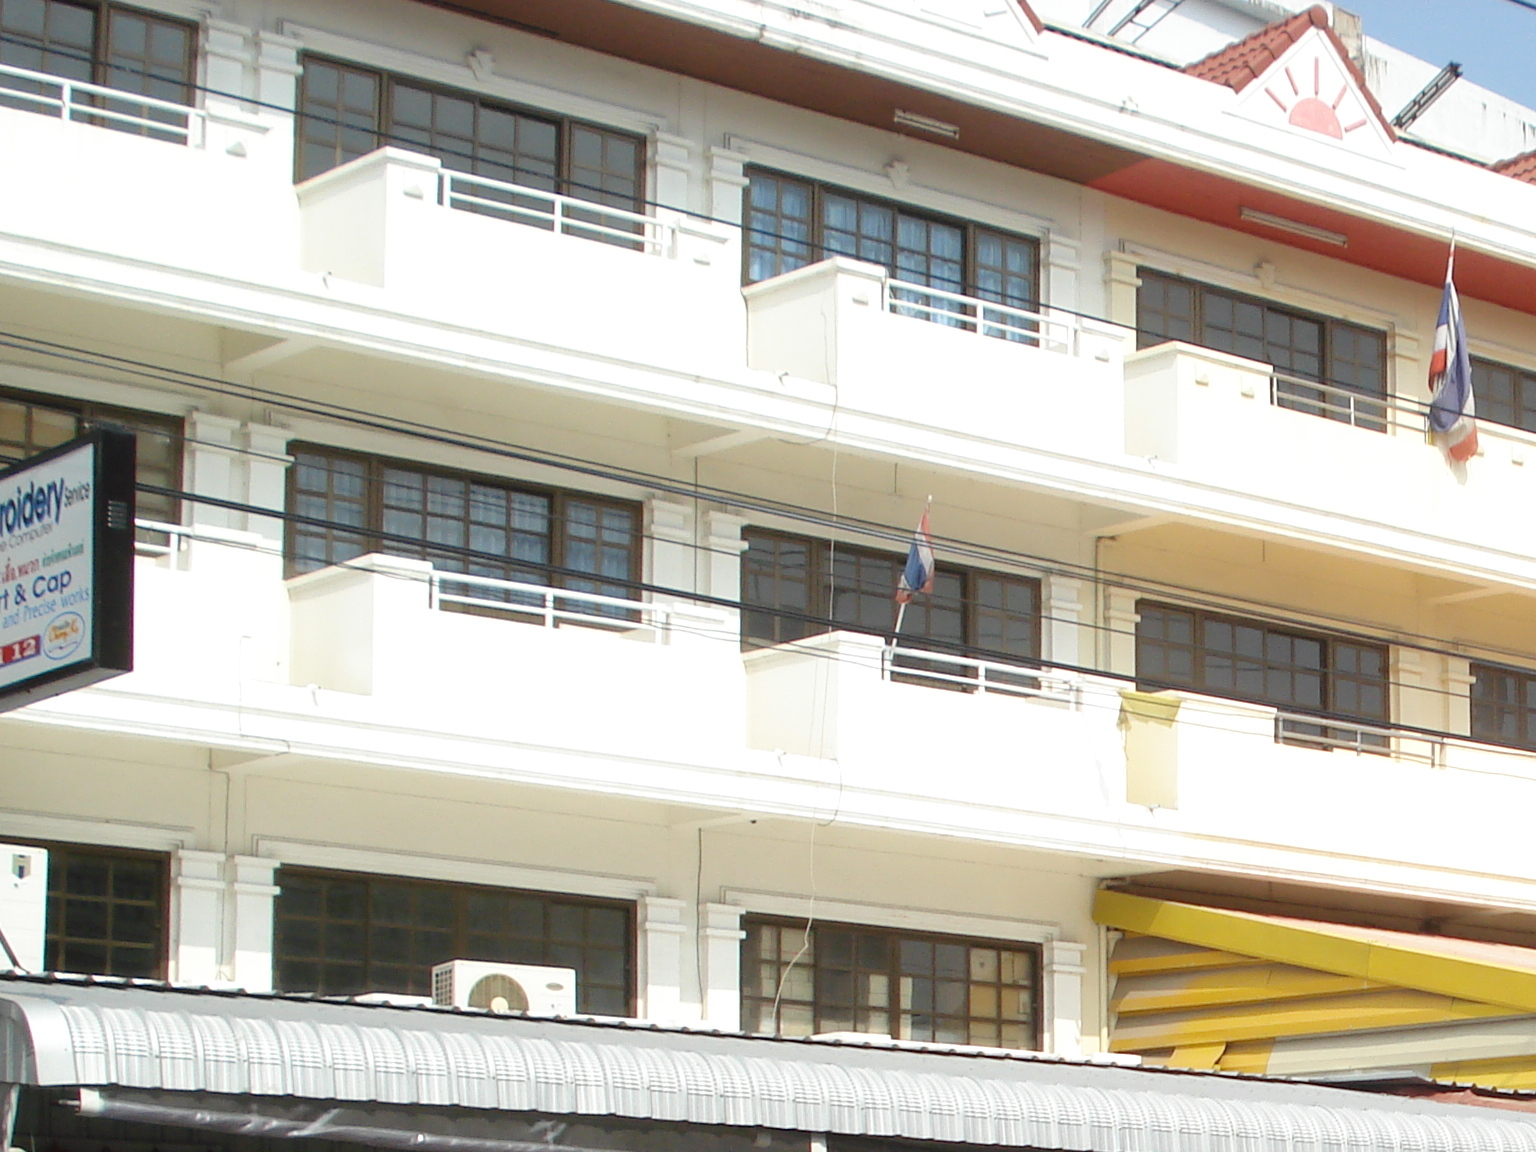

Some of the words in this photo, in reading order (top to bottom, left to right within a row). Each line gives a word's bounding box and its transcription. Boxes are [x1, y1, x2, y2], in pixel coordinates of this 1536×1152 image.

[14, 583, 27, 606] &
[32, 570, 72, 598] Cap
[12, 638, 37, 659] 12
